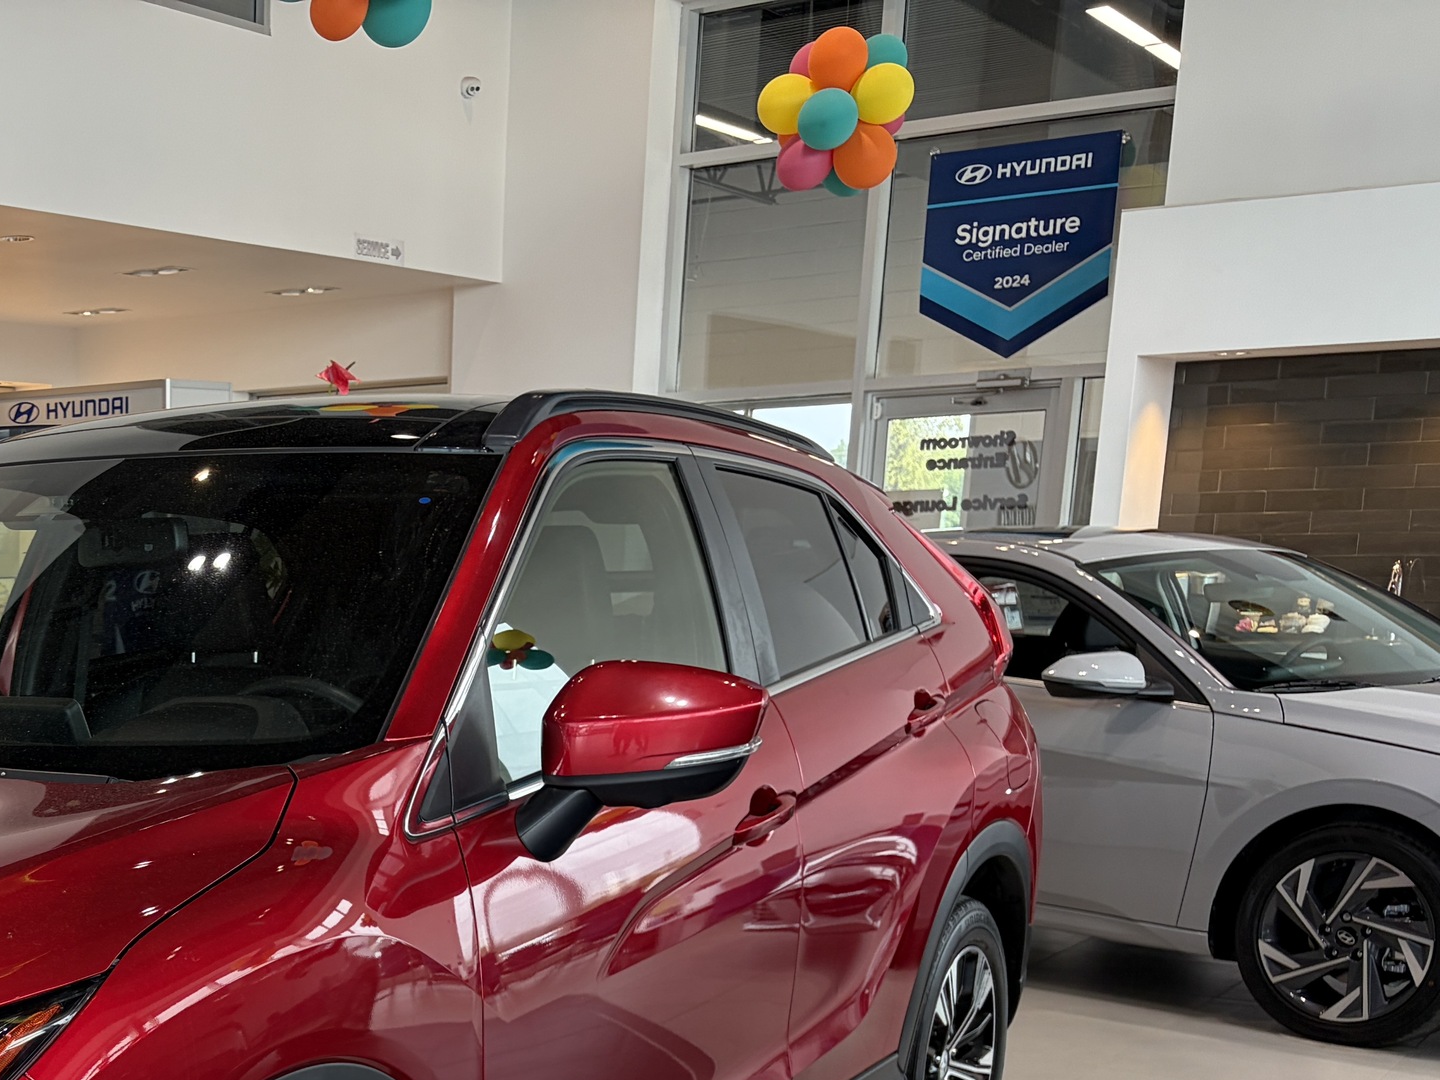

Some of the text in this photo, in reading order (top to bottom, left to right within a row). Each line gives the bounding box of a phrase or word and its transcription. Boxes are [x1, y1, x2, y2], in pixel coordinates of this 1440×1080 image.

[997, 152, 1093, 179] HYUNDAI
[955, 215, 1081, 247] Signature
[356, 238, 390, 260] SERVICE
[962, 240, 1069, 262] Certified Dealer
[993, 274, 1031, 289] 2024
[46, 396, 129, 420] HYUNDAI
